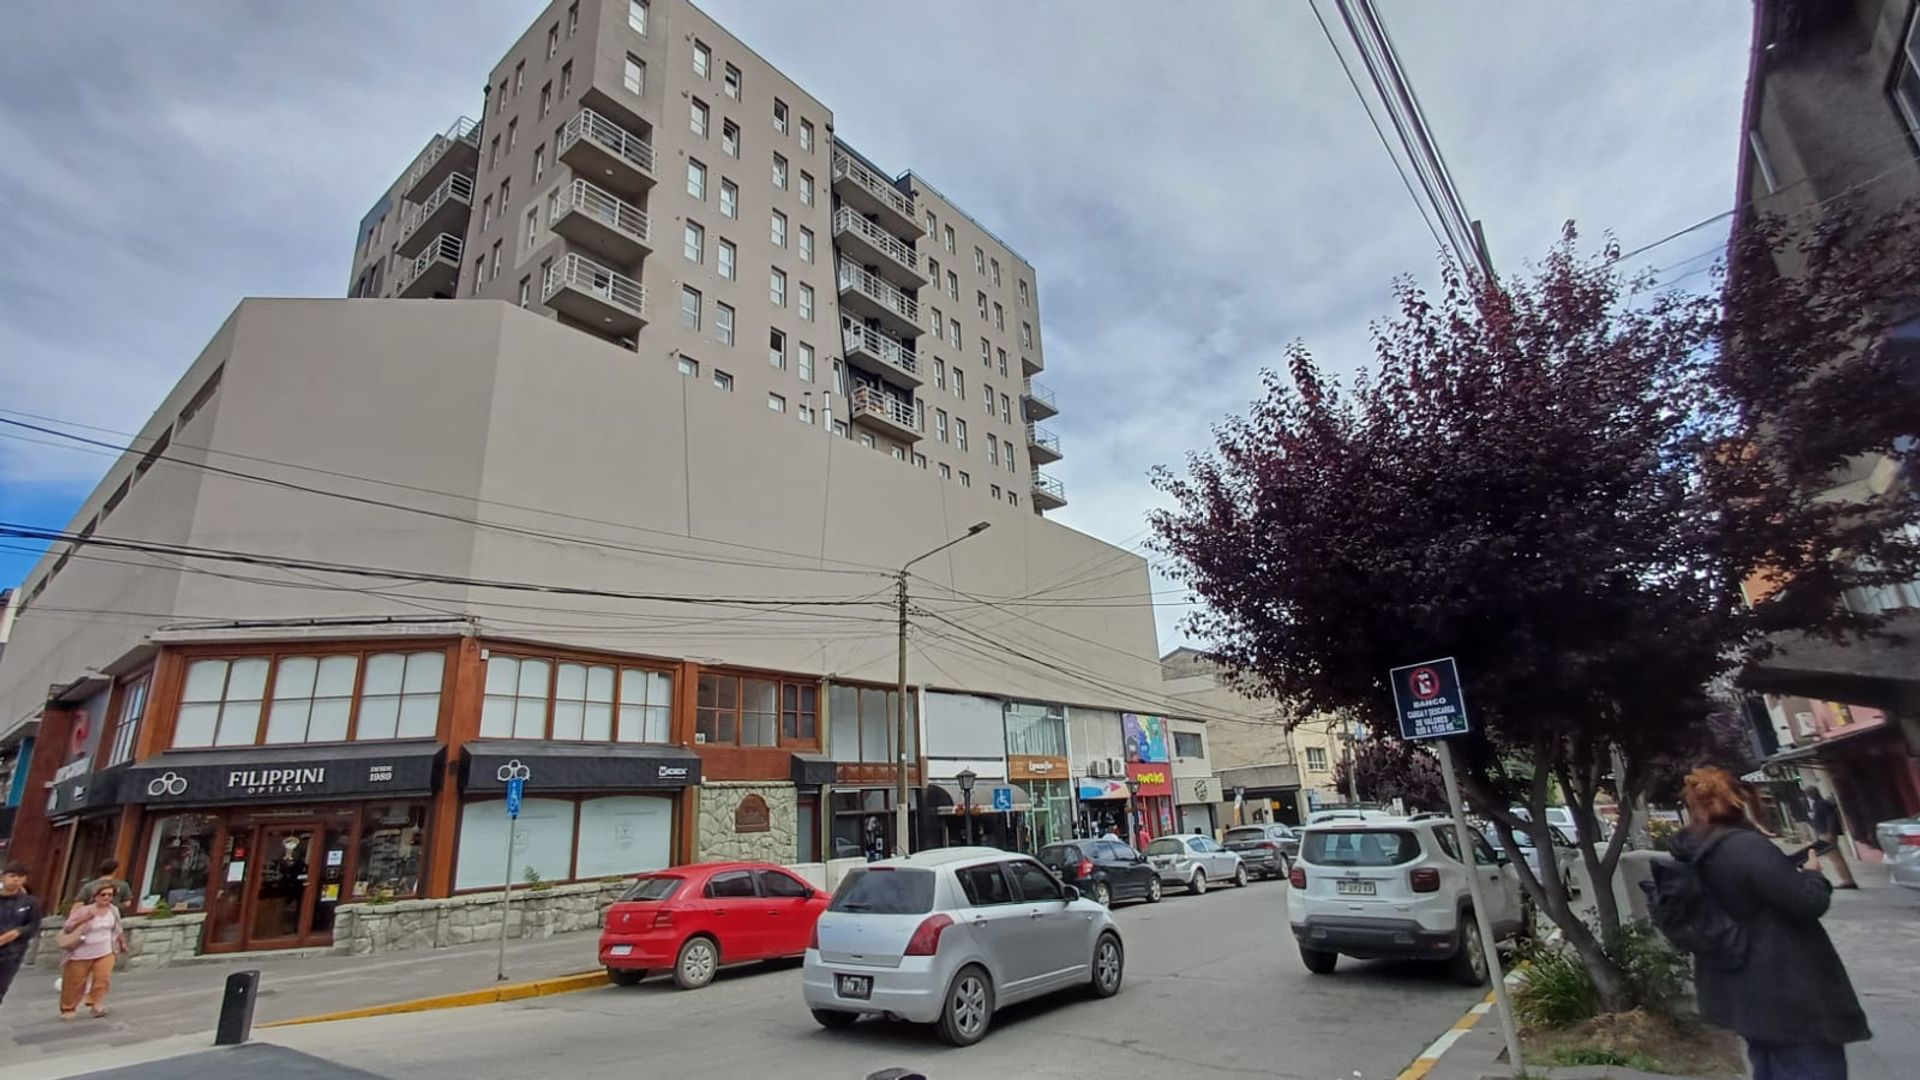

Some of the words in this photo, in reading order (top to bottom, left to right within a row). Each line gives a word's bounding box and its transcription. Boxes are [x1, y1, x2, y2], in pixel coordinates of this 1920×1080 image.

[1413, 697, 1446, 708] BANCO
[1407, 710, 1424, 719] CARGA
[1428, 705, 1456, 717] DESCARGA
[1415, 719, 1423, 727] DE
[1424, 715, 1448, 725] VALORES
[228, 768, 325, 787] FILIPPINI
[369, 772, 393, 782] 1989
[248, 785, 303, 794] OPTICA
